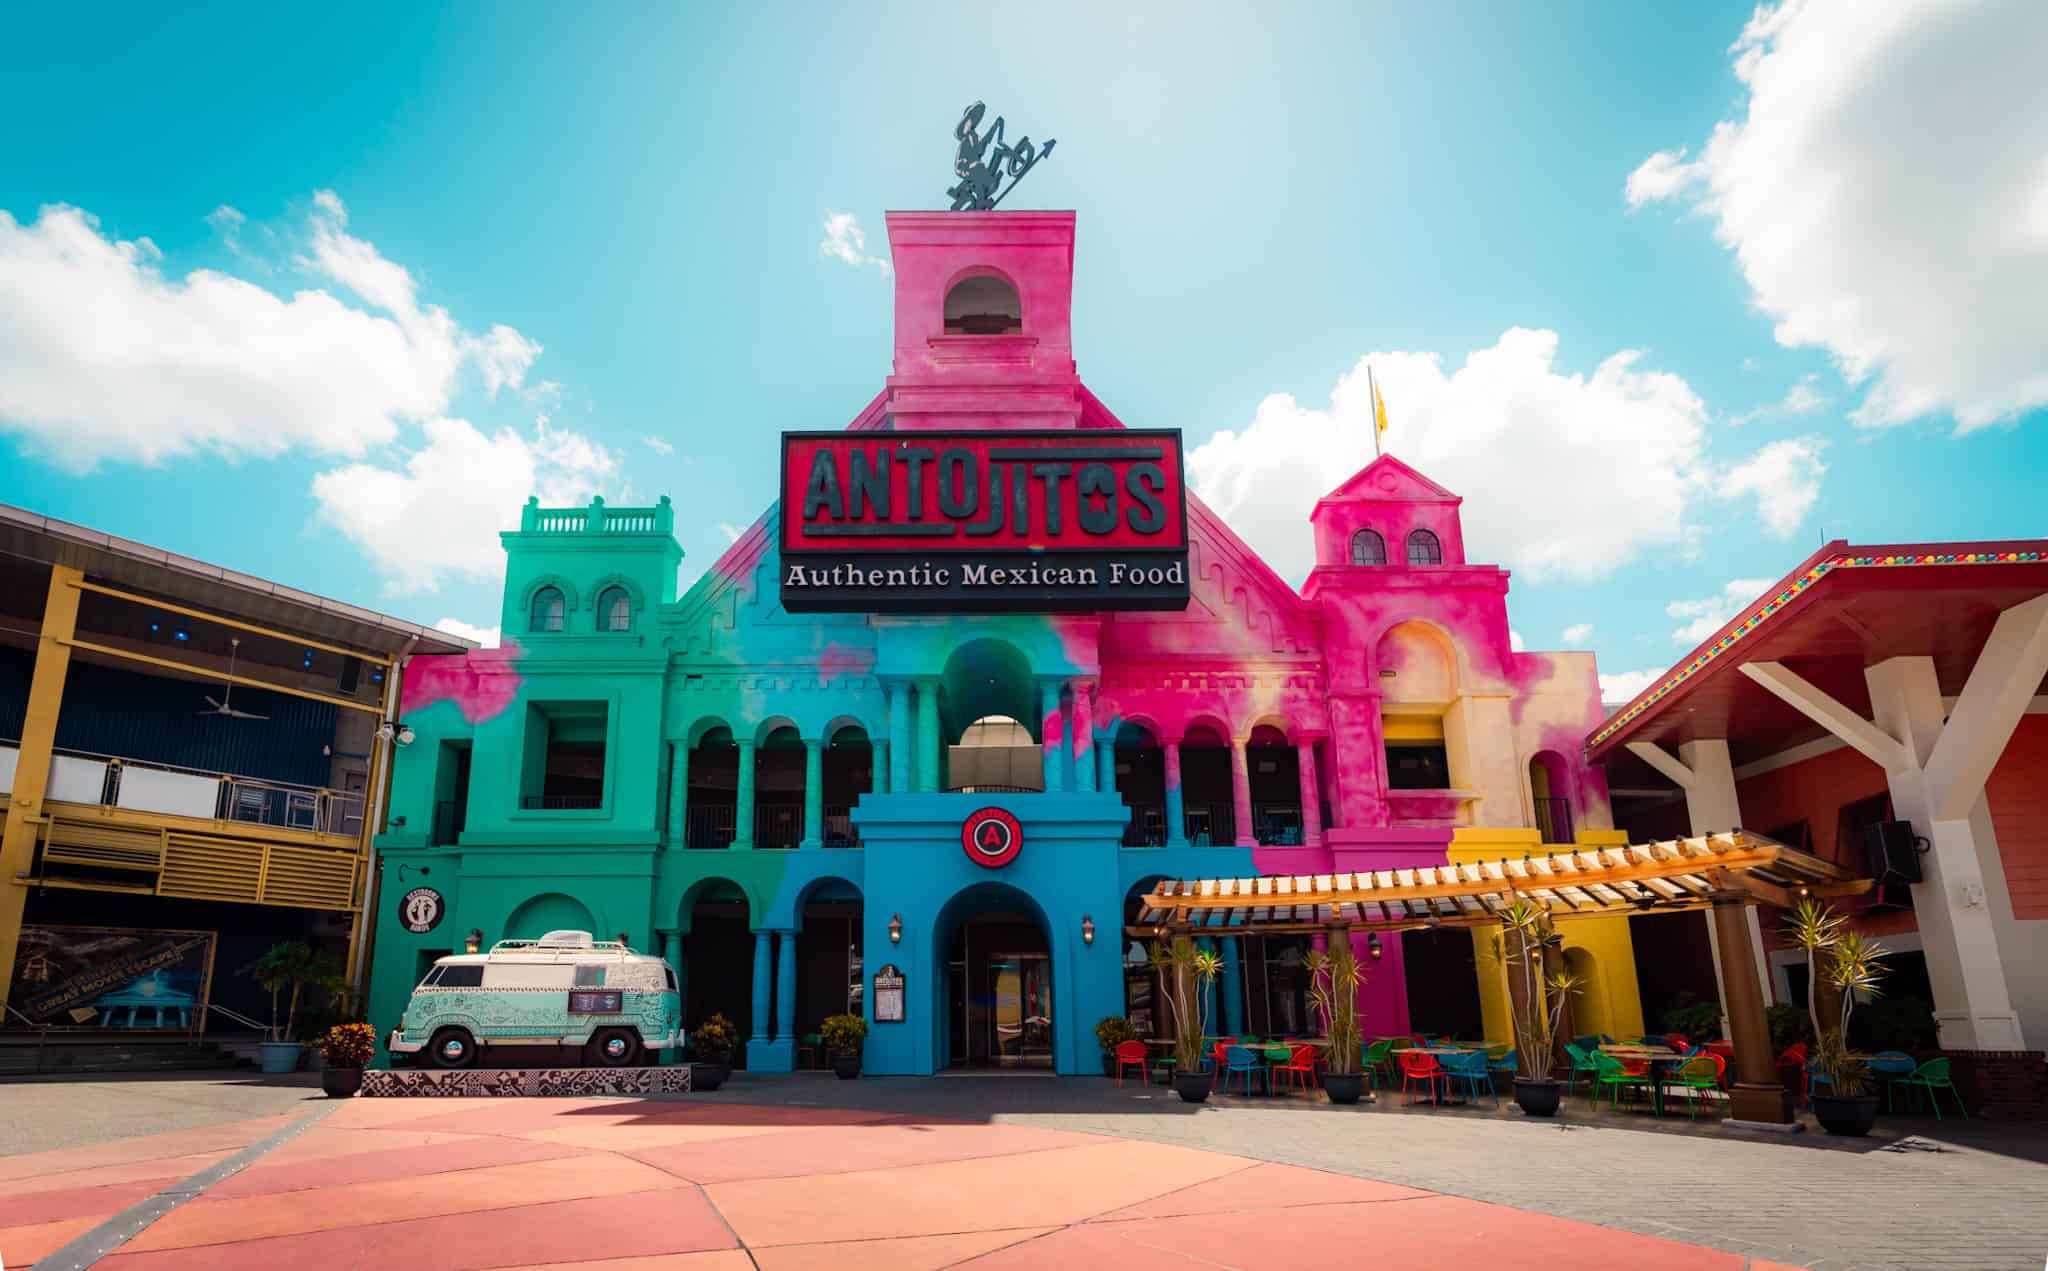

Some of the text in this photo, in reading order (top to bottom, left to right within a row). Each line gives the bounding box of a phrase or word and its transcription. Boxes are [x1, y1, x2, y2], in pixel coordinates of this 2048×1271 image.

[802, 446, 1167, 536] ANTOJITOS
[785, 562, 1185, 587] Authentic Mexican Food
[983, 825, 1002, 847] A
